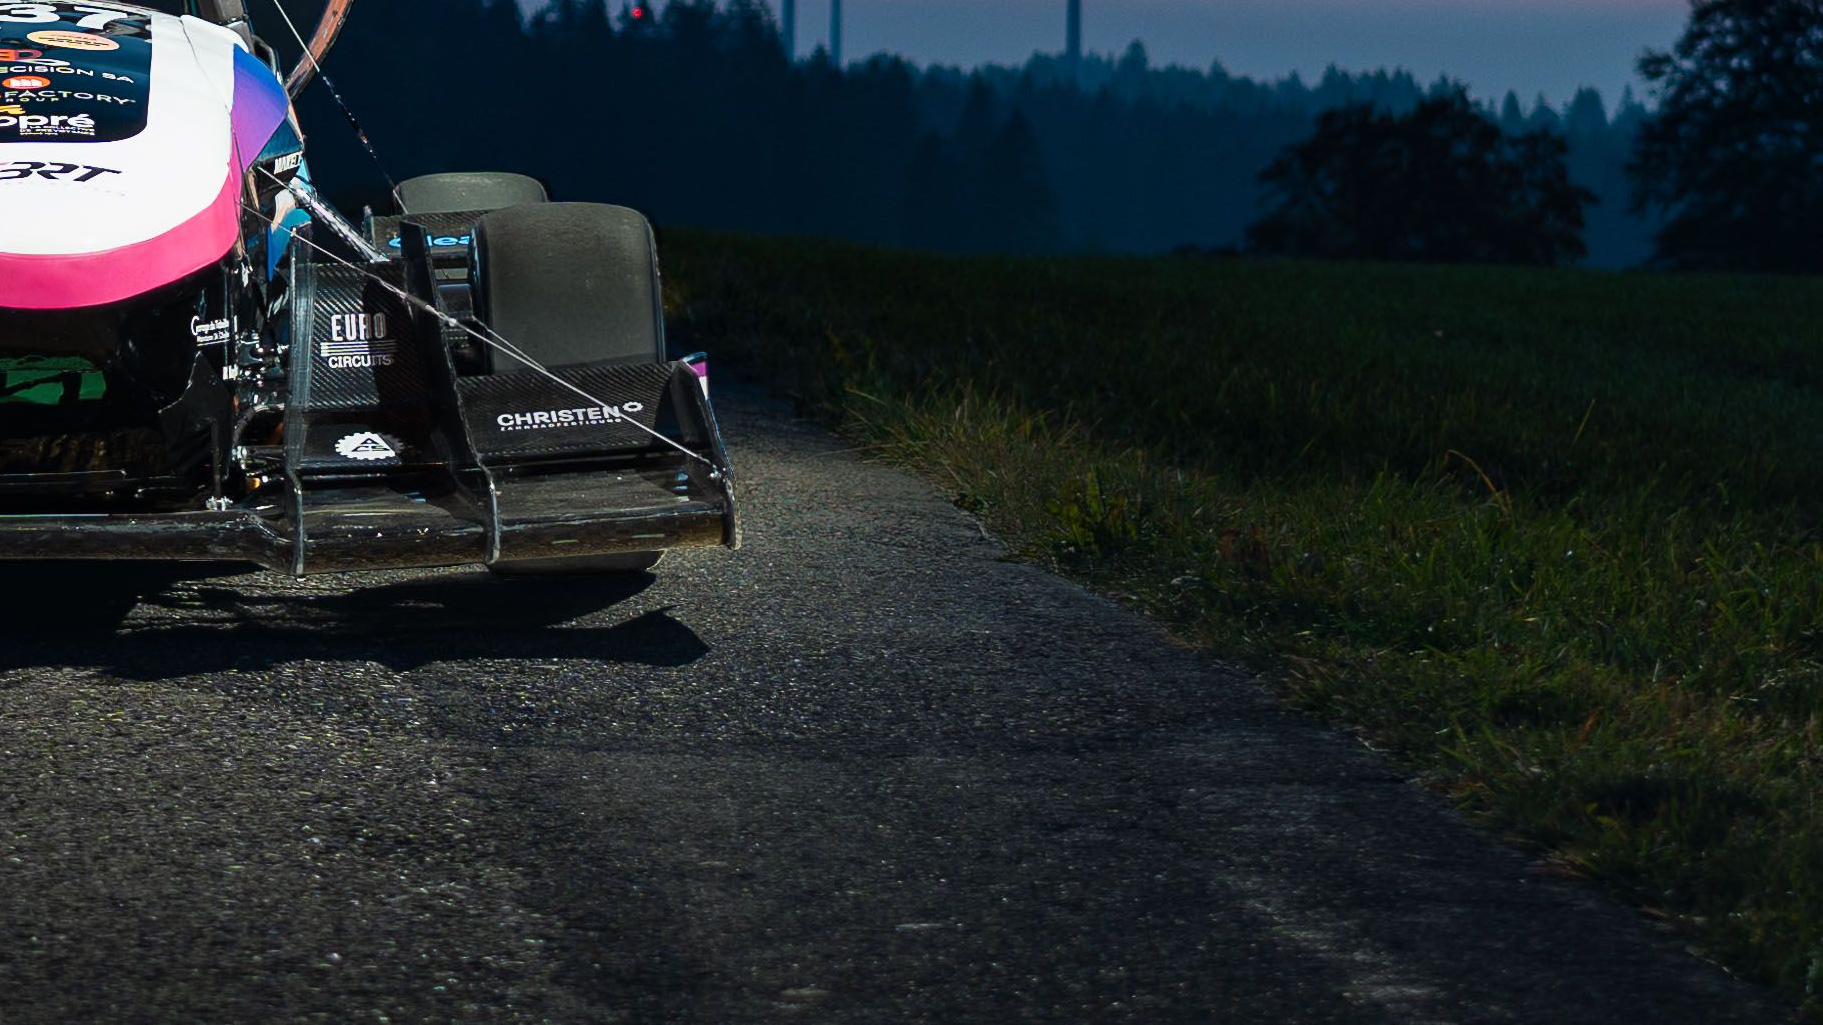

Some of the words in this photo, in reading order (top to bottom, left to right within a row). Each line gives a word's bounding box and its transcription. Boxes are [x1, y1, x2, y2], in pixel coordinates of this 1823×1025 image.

[101, 72, 135, 83] SA
[330, 312, 387, 341] EURO
[328, 354, 394, 368] CIRCUITS
[496, 405, 620, 426] CHRISTEN
